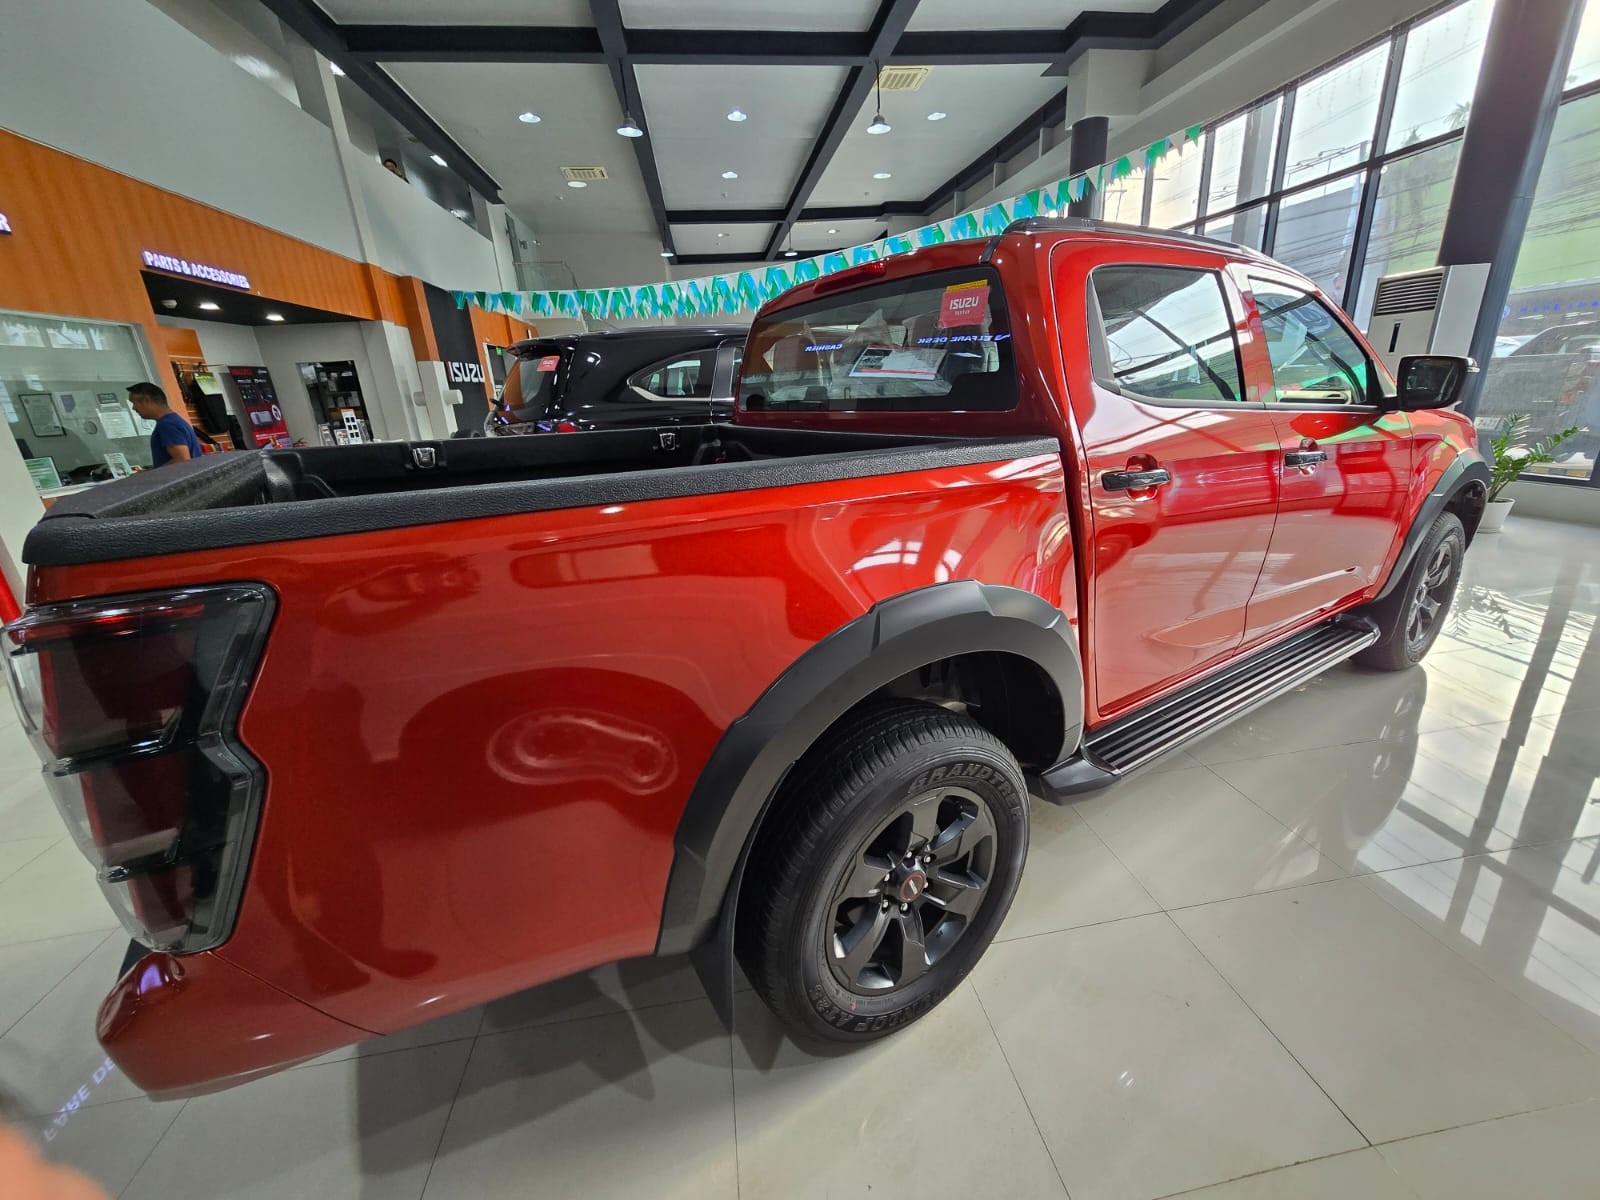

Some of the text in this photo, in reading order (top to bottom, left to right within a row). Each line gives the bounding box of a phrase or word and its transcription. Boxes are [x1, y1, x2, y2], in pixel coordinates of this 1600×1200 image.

[143, 250, 250, 289] PARTS & ACCESSORIES
[949, 295, 979, 310] ISUZU
[446, 361, 486, 383] ISUZU
